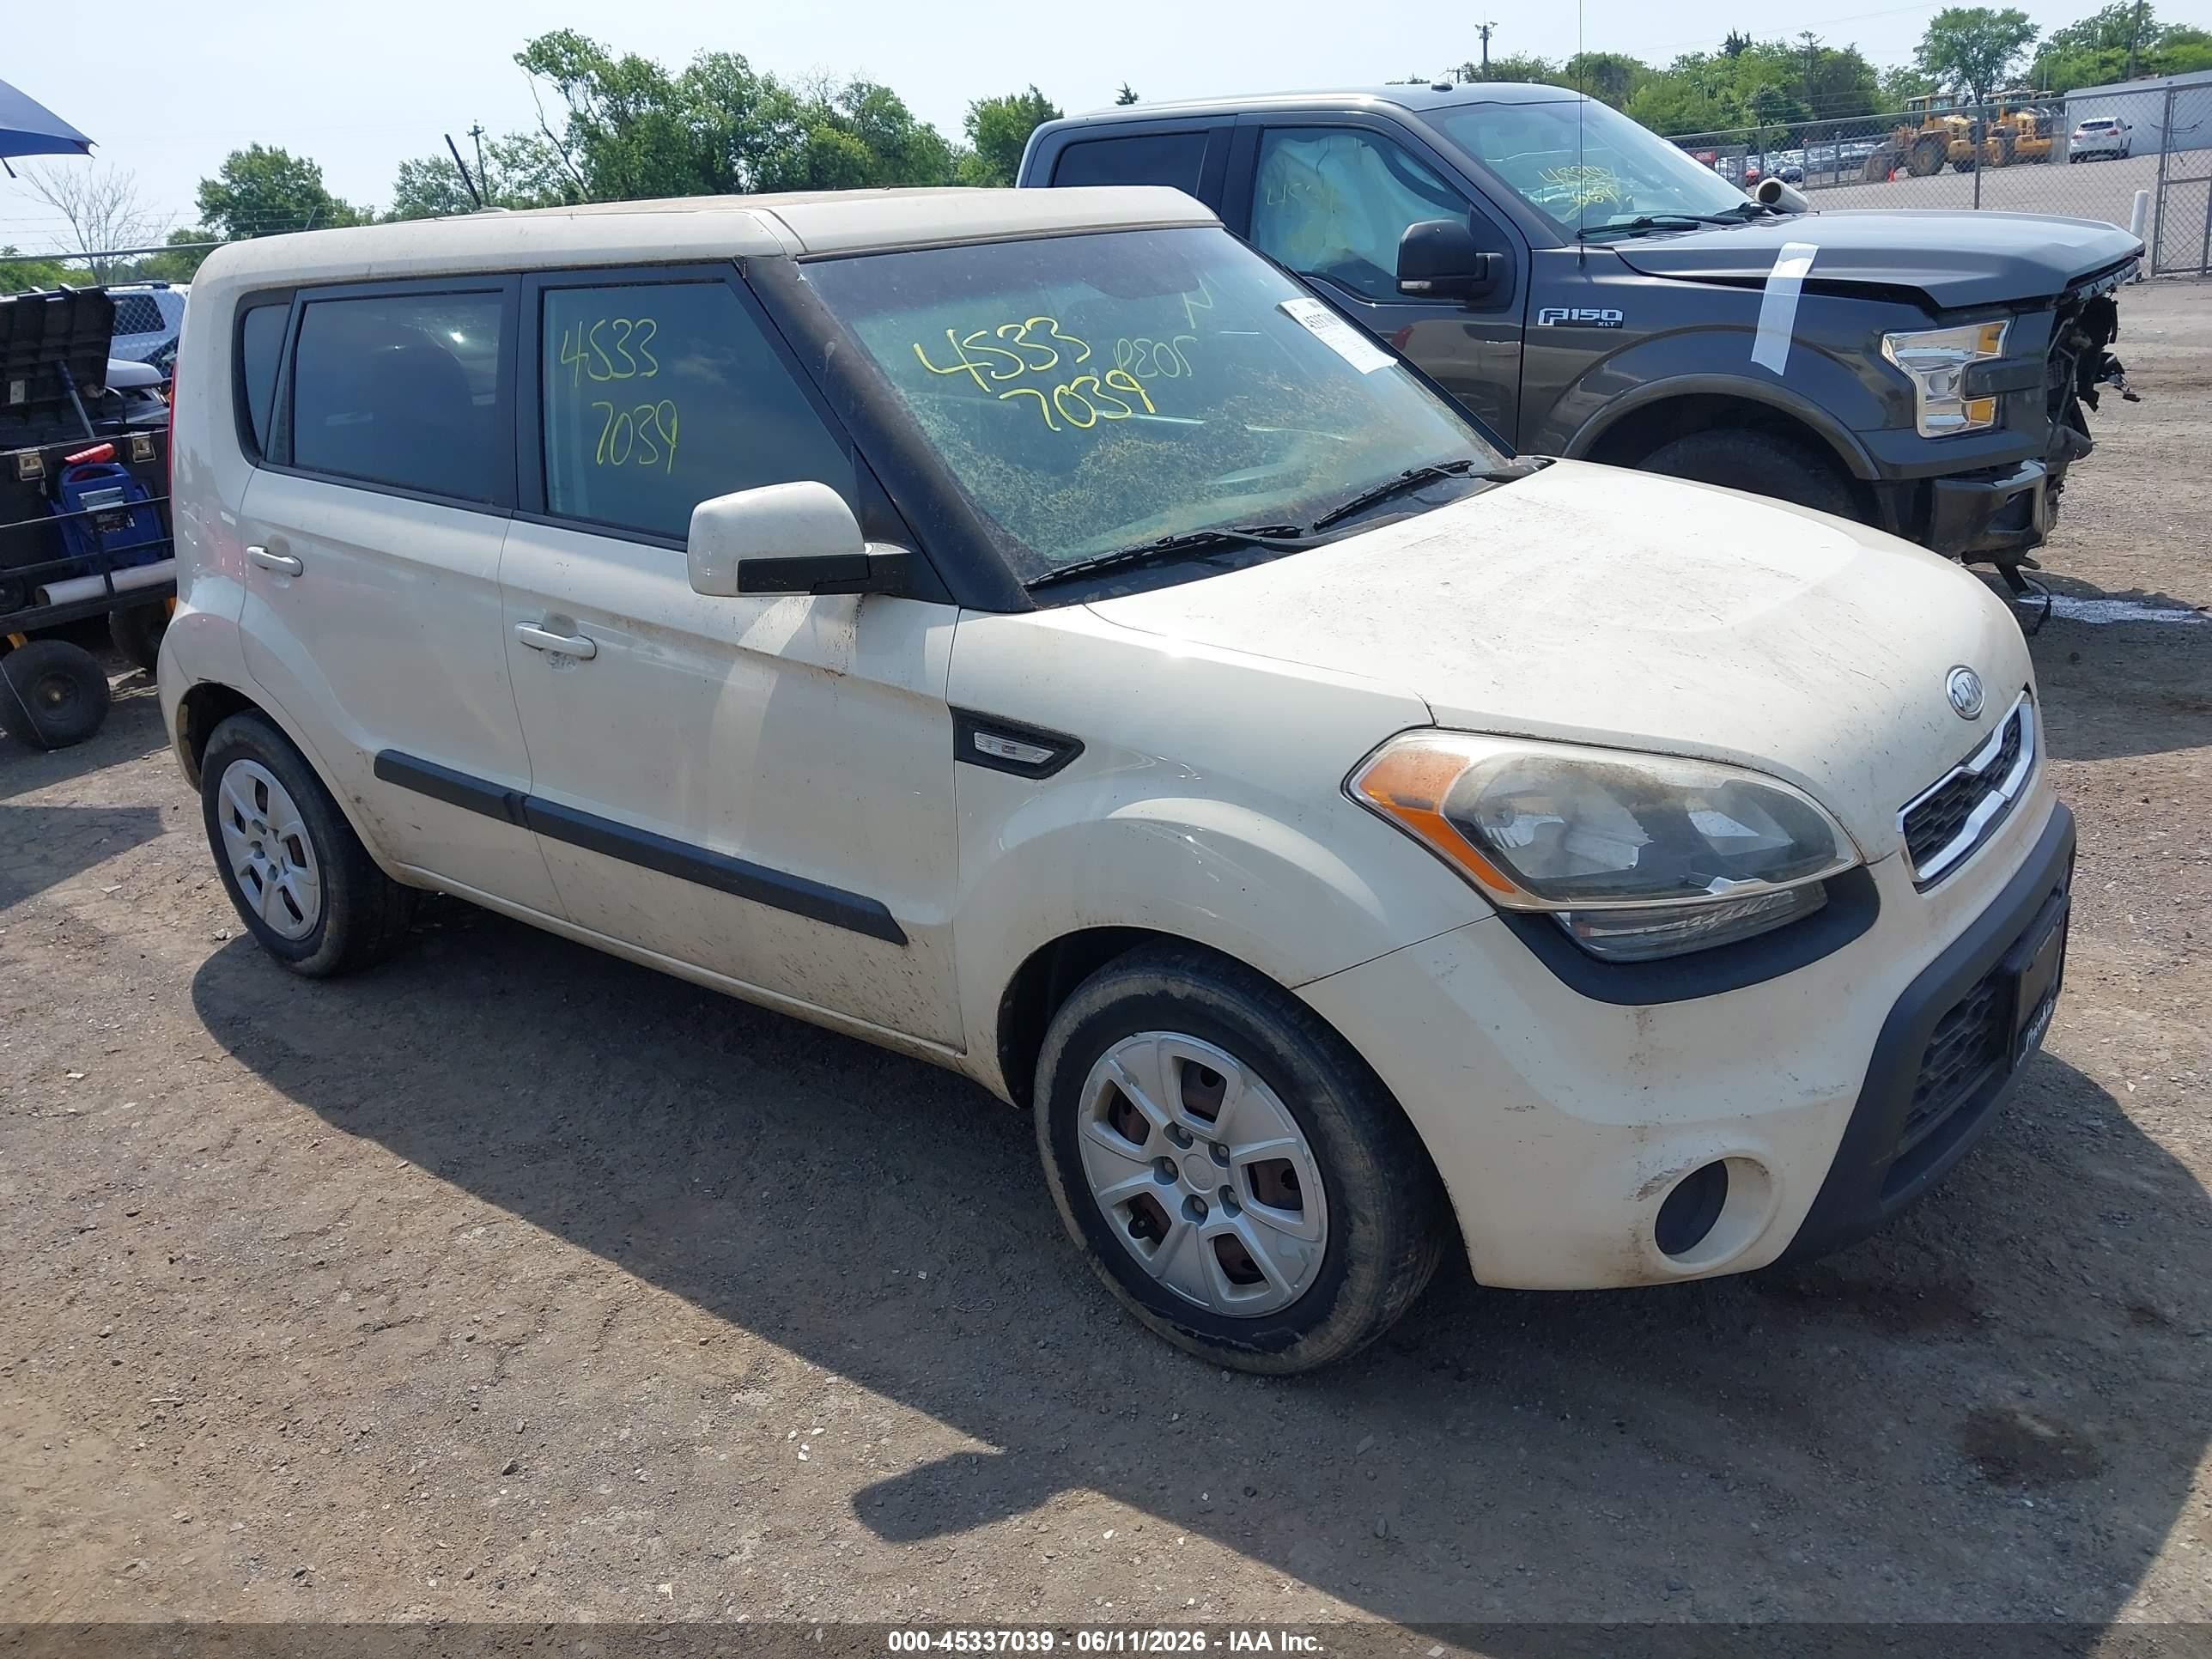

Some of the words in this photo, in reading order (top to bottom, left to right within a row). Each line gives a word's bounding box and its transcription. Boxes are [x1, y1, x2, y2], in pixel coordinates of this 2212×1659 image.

[1538, 307, 1623, 326] F150
[560, 318, 659, 388] 4533
[913, 316, 1091, 392] 4533
[998, 368, 1156, 431] 7039
[591, 398, 678, 475] 7039
